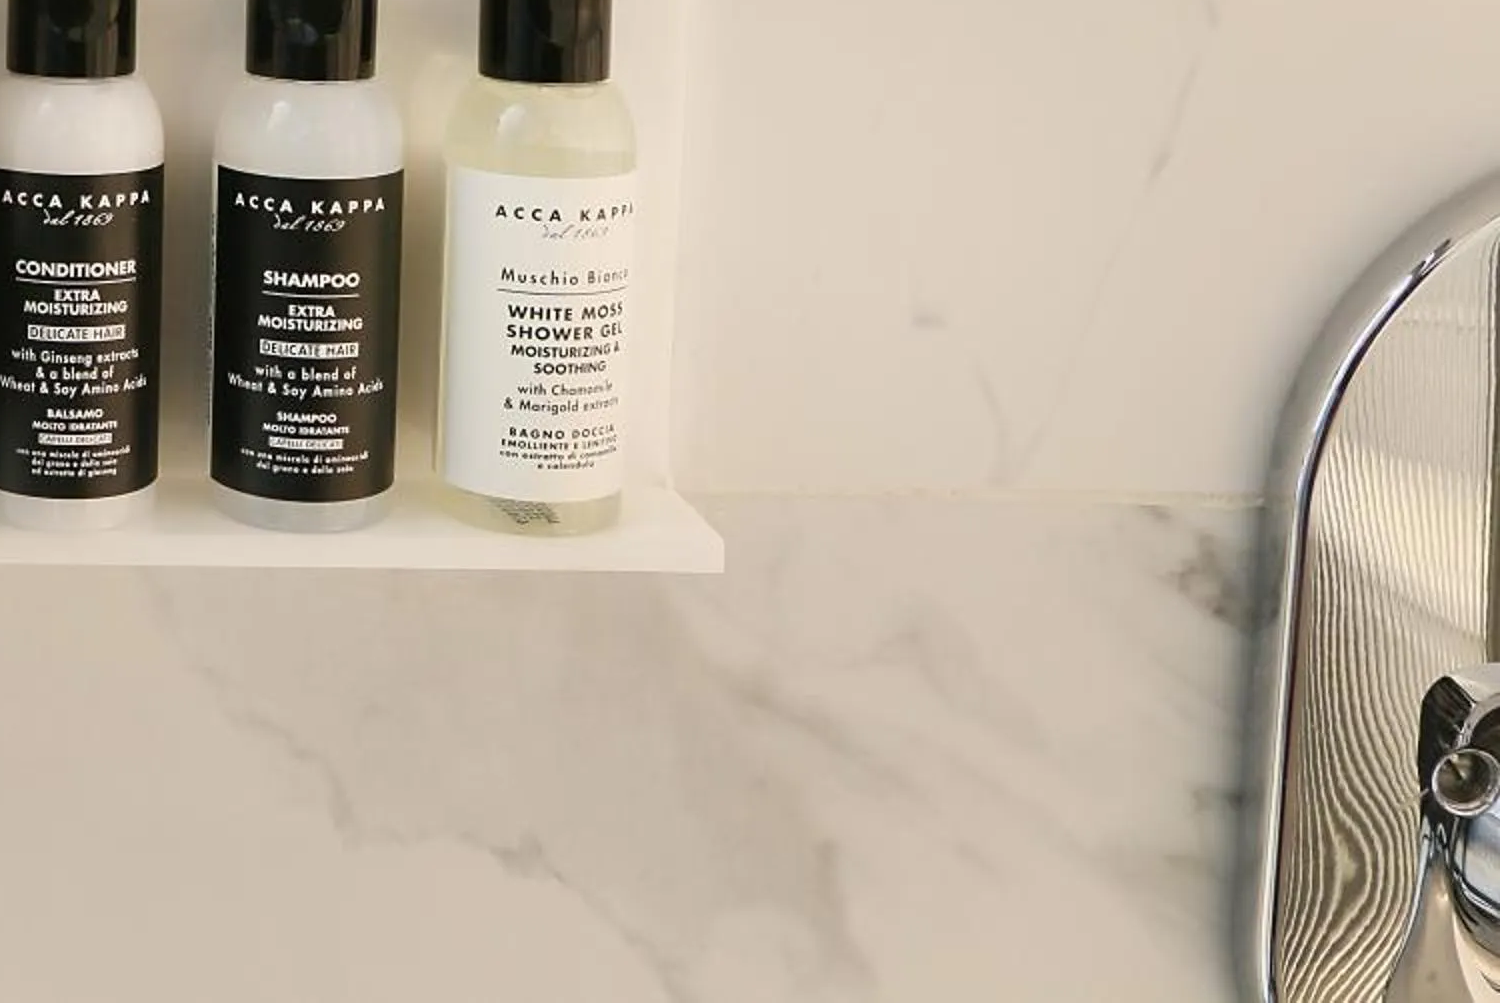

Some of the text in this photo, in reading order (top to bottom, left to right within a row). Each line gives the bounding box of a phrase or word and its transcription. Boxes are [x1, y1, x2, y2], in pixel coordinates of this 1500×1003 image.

[2, 190, 150, 210] ACCA KAPPA
[235, 192, 385, 214] ACCA KAPPA
[495, 204, 562, 222] ACCA
[304, 218, 346, 232] 1869
[15, 258, 137, 278] CONDITIONER
[263, 269, 360, 288] SHAMPOO
[501, 267, 579, 286] Muschio
[54, 289, 101, 302] EXTRA
[24, 301, 129, 316] MOISTURIZING
[288, 304, 336, 318] EXTRA
[508, 301, 623, 321] WHITE MOSS
[257, 314, 364, 331] MOISTURIZING
[29, 327, 124, 340] DELICATE HAIR
[506, 322, 622, 341] SHOWER GEL
[261, 340, 357, 357] DELICATE HAIR
[511, 343, 611, 358] MOISTURIZING
[11, 348, 37, 362] with
[41, 350, 93, 367] Ginseng
[35, 365, 115, 380] & a blend of
[254, 365, 357, 381] with a blend of
[534, 360, 607, 375] SOOTHING
[0, 373, 148, 398] Wheat & Soy Amino Acids
[227, 372, 384, 400] Wheat & Soy Amino Acids
[517, 382, 547, 396] with
[504, 396, 513, 409] &
[519, 398, 579, 415] Marigold
[47, 408, 104, 420] BALSAMO
[276, 411, 337, 424] SHAMPOO
[32, 420, 67, 432] MOLTO
[262, 422, 297, 434] MOLTO
[509, 427, 565, 439] BAGNO
[501, 438, 569, 450] EMOLLIENTE
